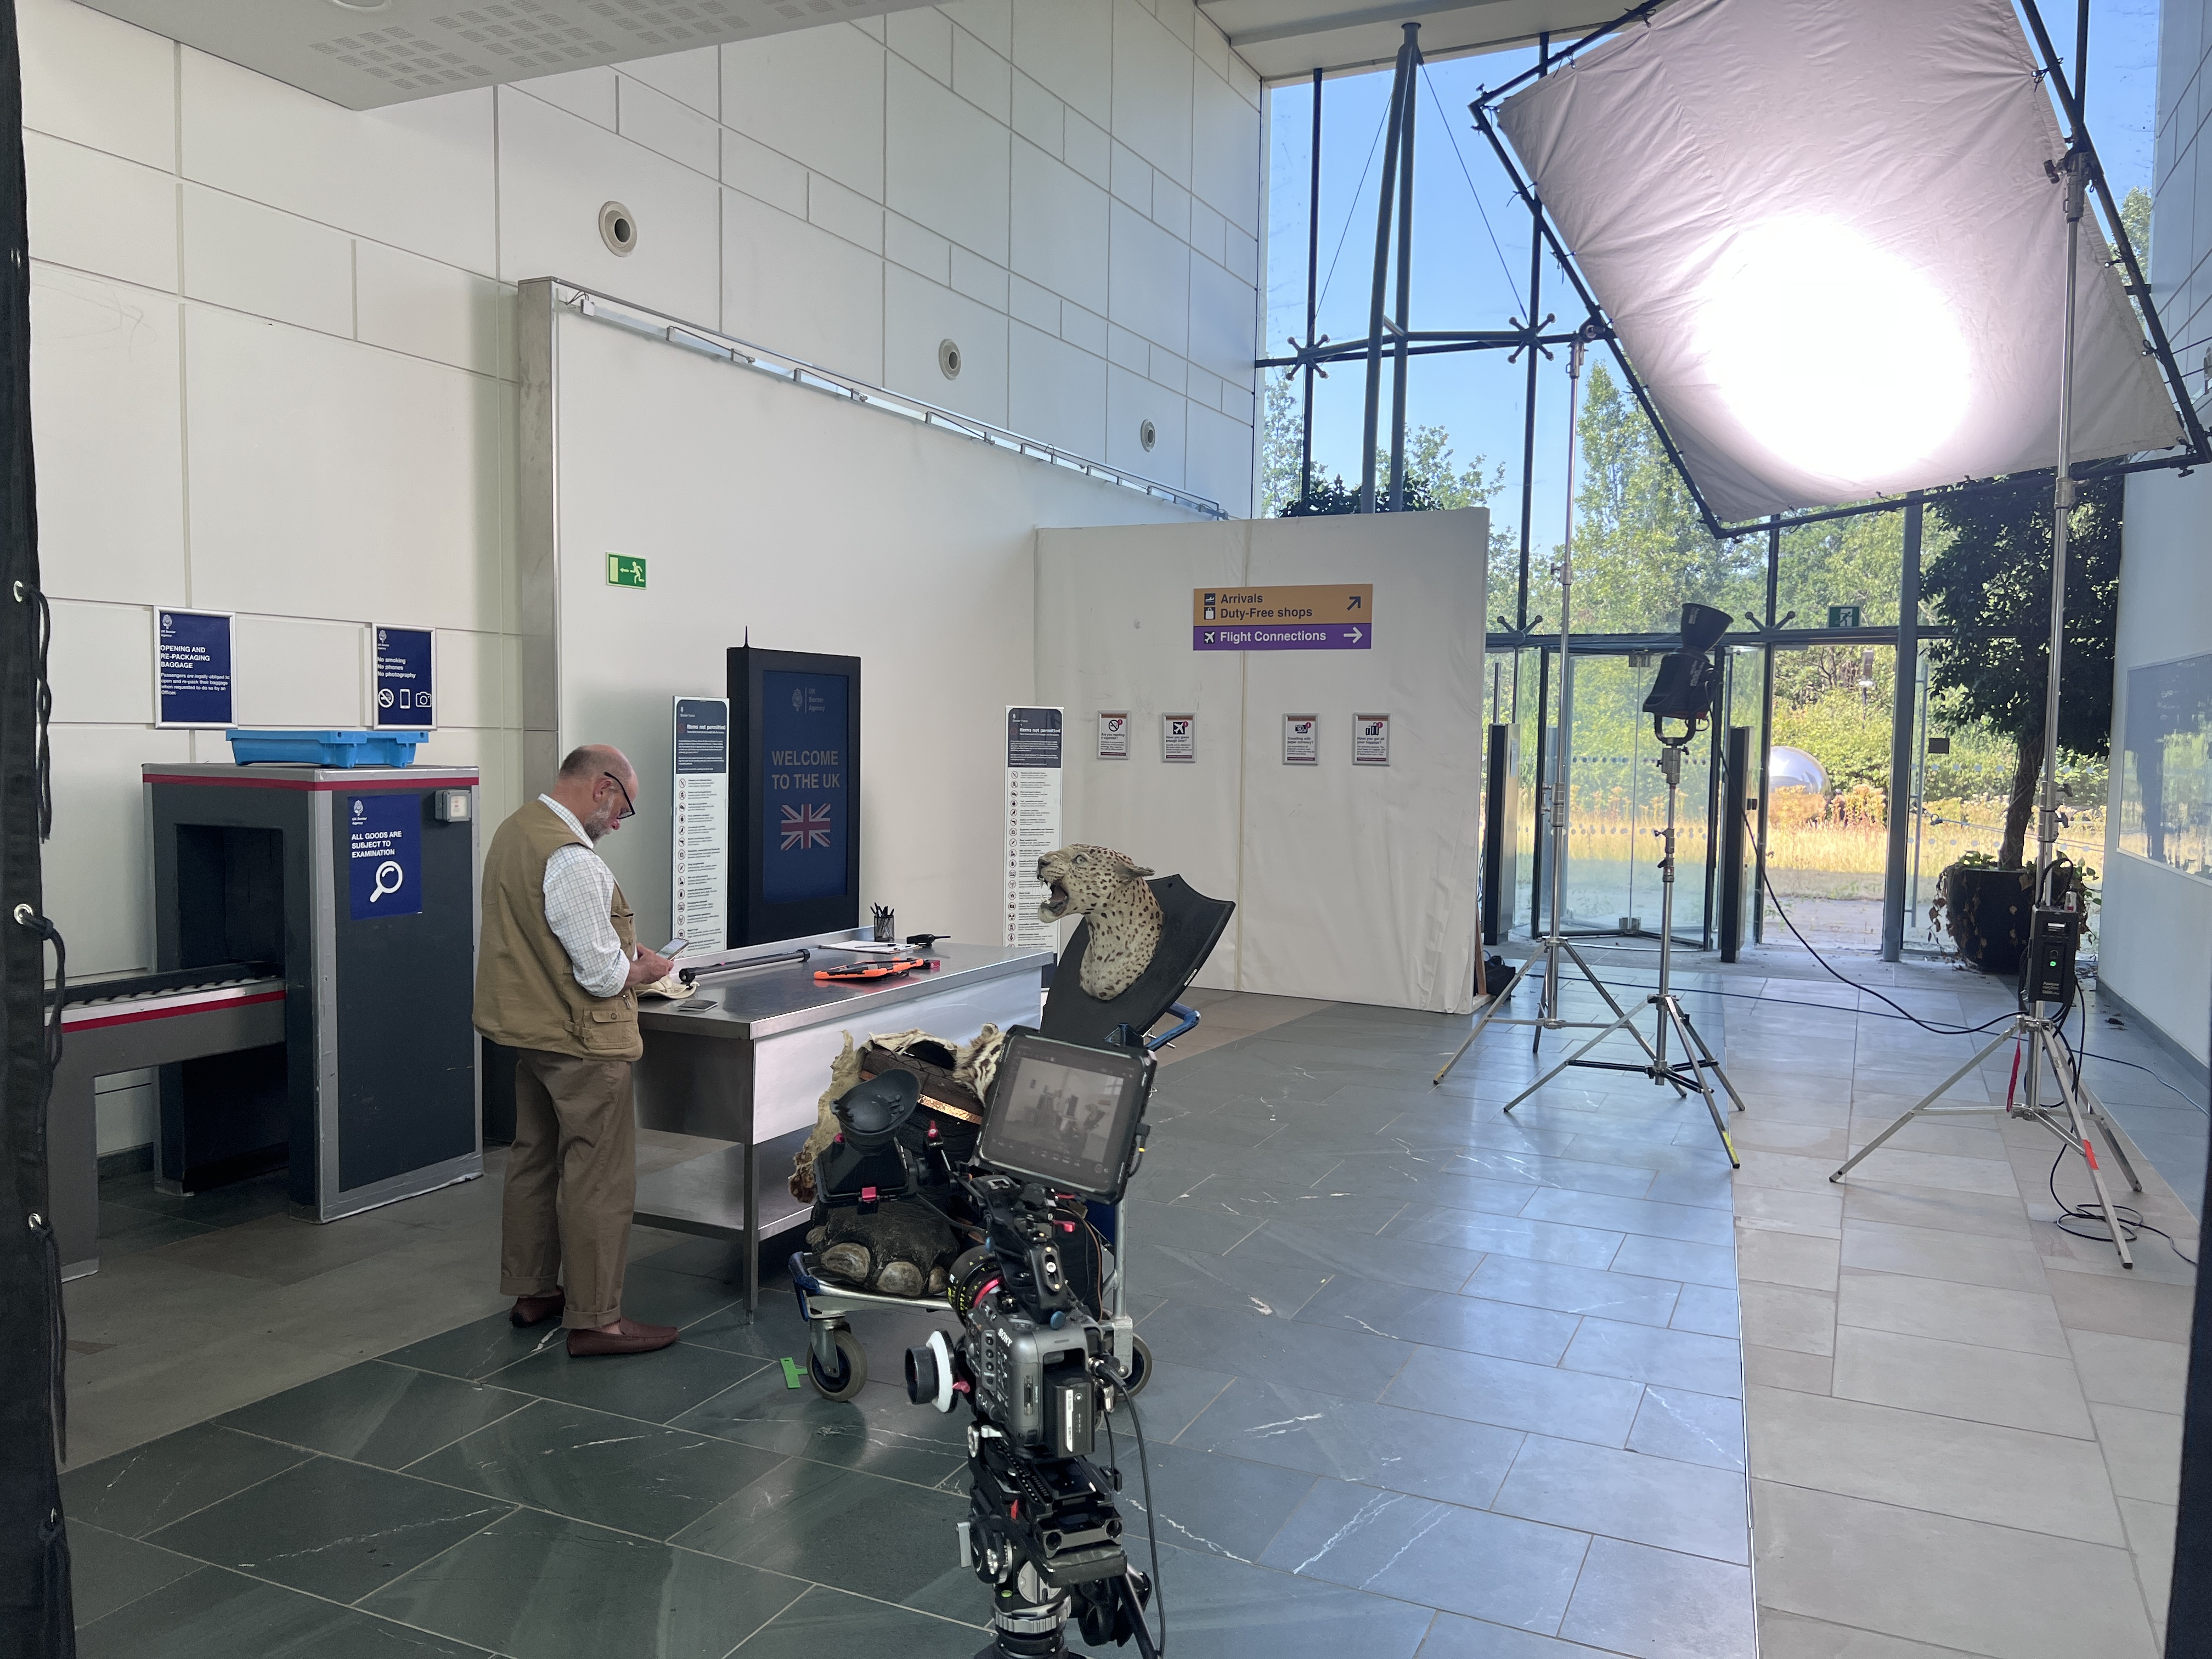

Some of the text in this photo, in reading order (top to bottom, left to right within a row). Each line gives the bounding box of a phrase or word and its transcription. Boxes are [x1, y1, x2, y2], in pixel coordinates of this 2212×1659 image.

[1221, 594, 1263, 604] Arrivals
[1221, 607, 1312, 620] Duty-Free shops
[1220, 630, 1327, 644] Flight Connections
[160, 653, 210, 661] RE-PACKAGING
[772, 750, 839, 766] WELCOME
[771, 773, 840, 789] TO THE UK
[365, 831, 388, 839] GOODS
[352, 840, 381, 849] SUBJECT
[352, 848, 395, 858] EXAMINATION
[997, 1328, 1013, 1347] SONY
